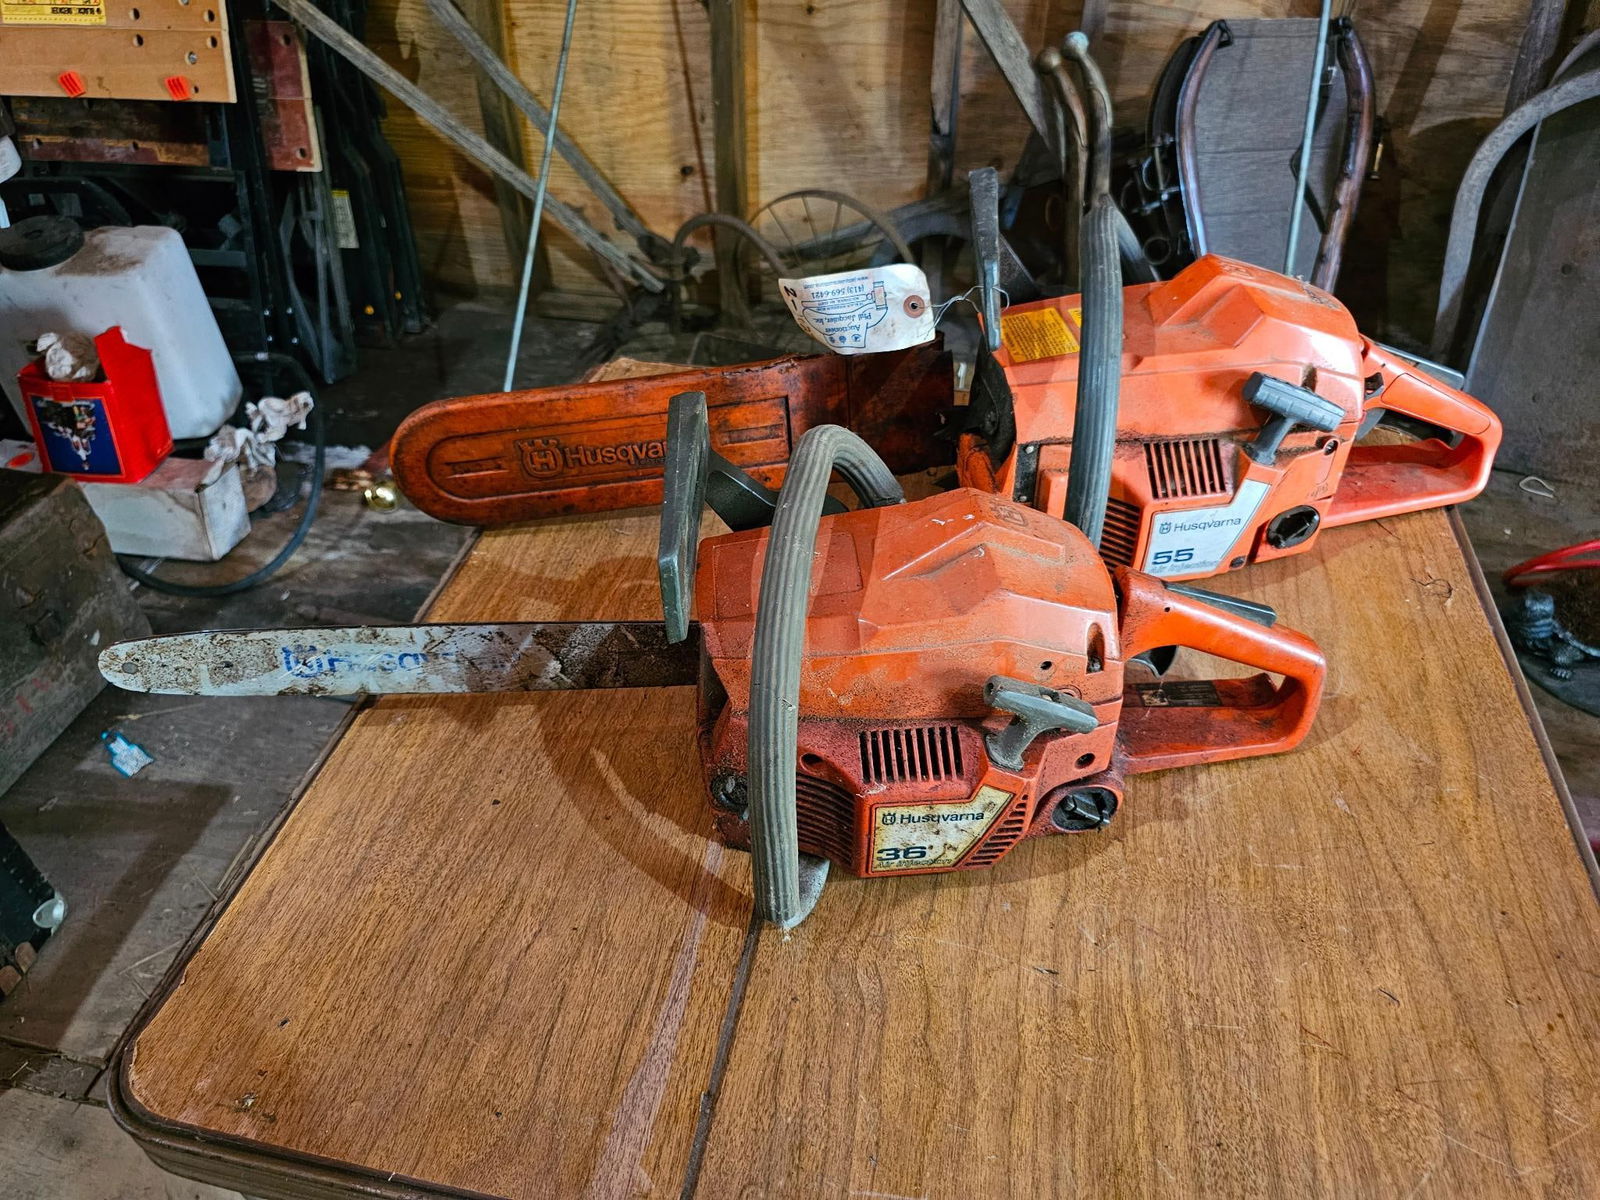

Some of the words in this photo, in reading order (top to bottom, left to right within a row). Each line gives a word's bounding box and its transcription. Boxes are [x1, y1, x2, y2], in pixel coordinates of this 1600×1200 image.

[847, 284, 864, 294] (413)
[1173, 517, 1242, 533] Husqvarna
[1151, 548, 1195, 565] 55
[900, 811, 985, 825] Husqvarna
[876, 846, 927, 862] 36
